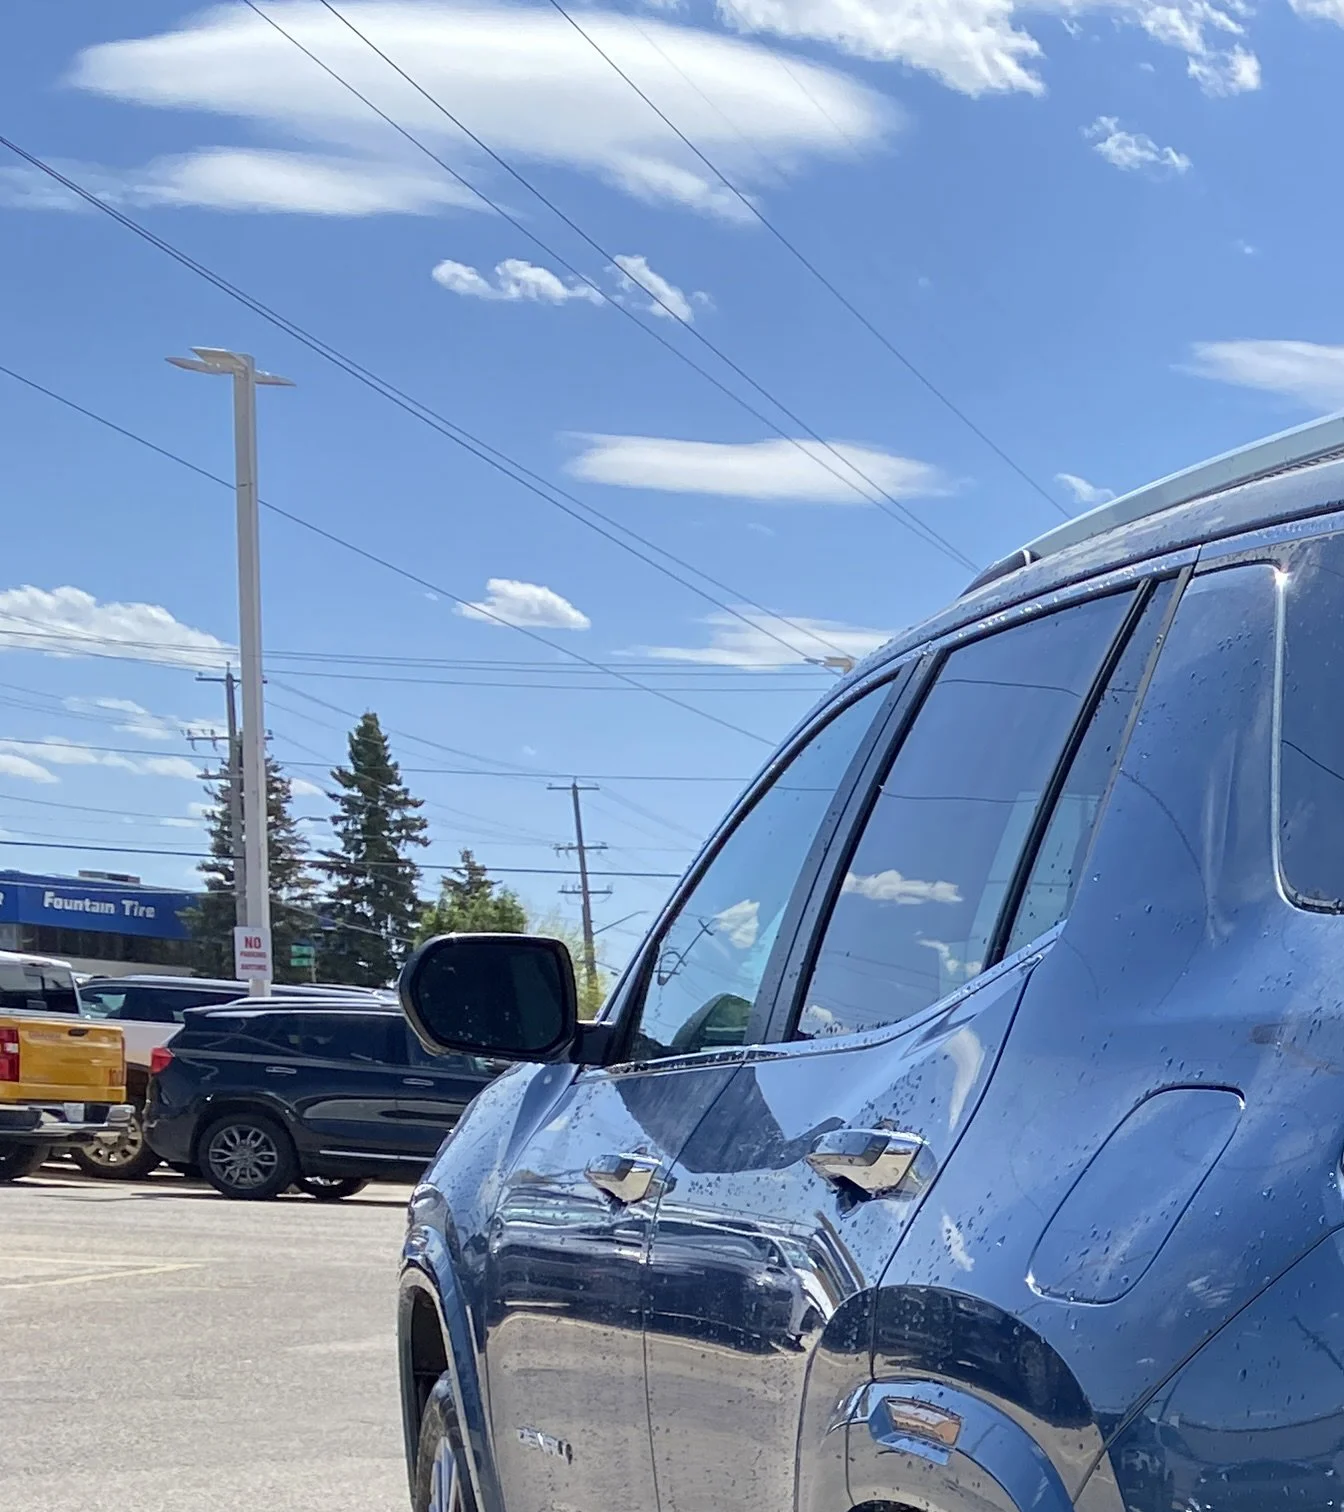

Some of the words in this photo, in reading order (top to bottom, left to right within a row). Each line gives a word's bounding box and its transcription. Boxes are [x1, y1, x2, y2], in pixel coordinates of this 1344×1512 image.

[43, 891, 115, 914] Fountain
[121, 899, 155, 918] Tire
[244, 936, 262, 949] NO
